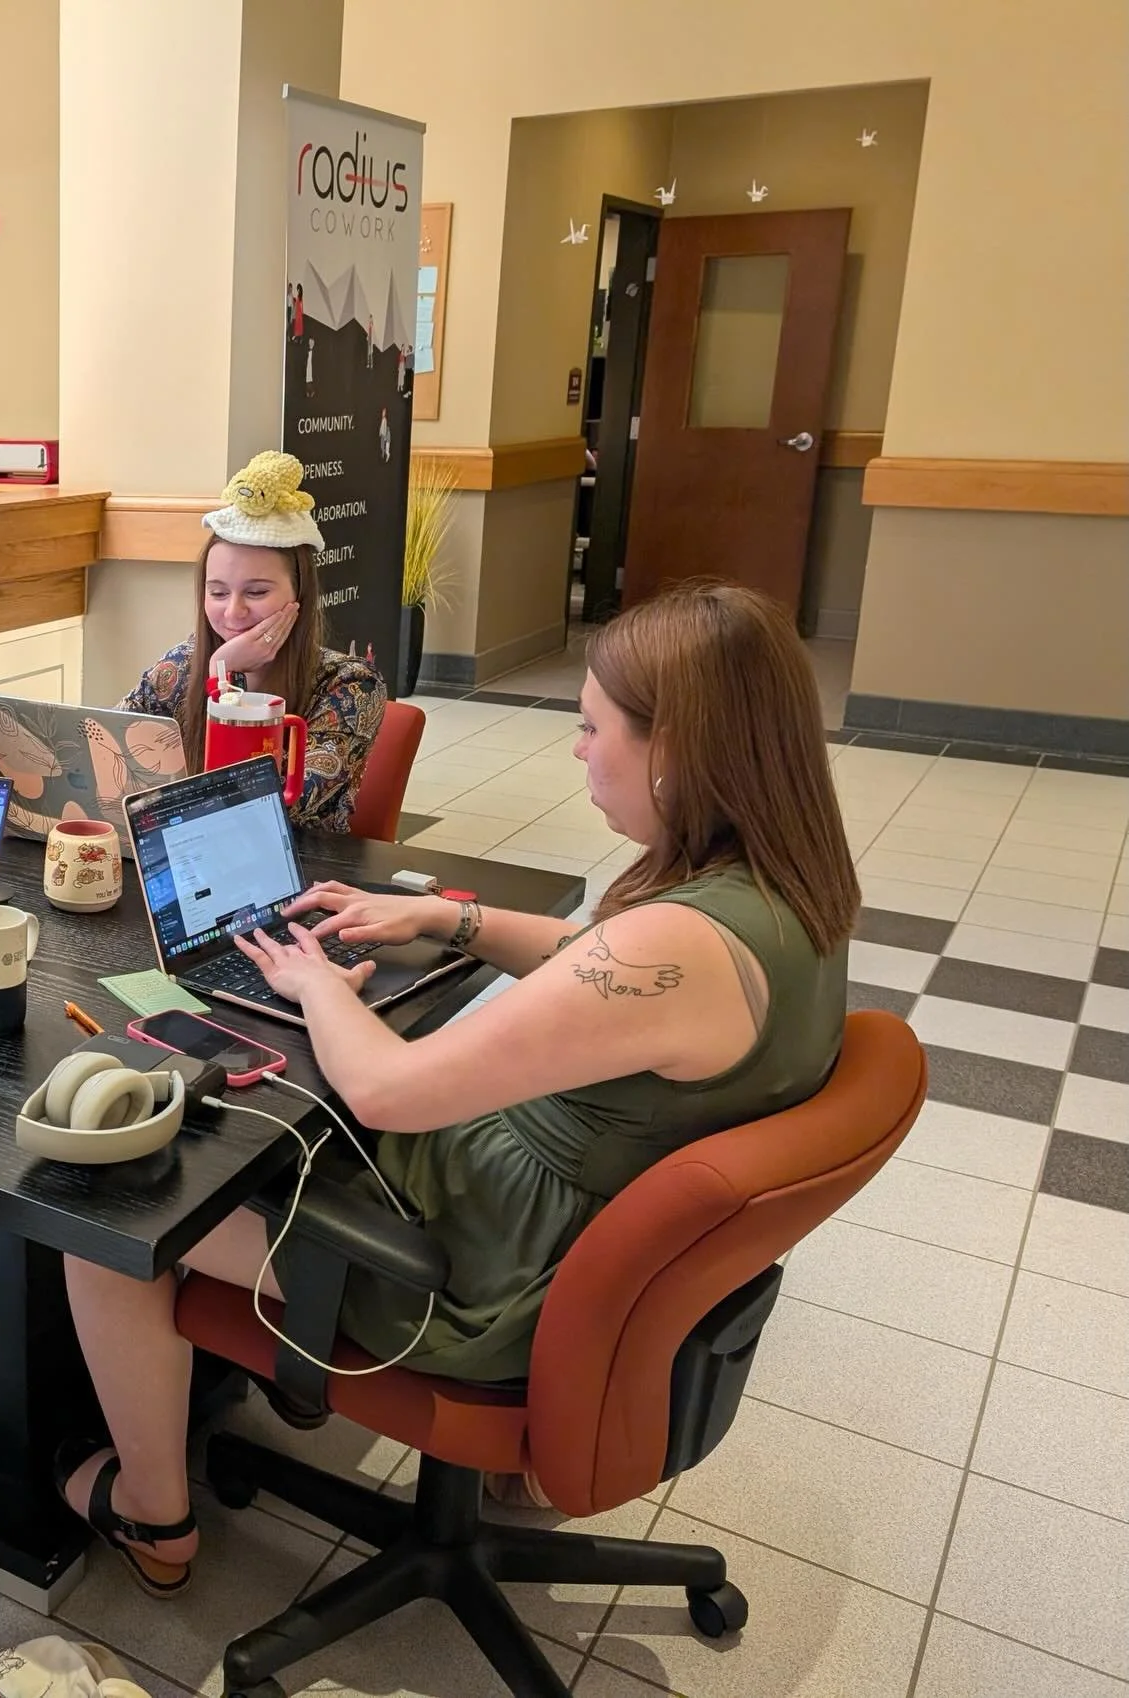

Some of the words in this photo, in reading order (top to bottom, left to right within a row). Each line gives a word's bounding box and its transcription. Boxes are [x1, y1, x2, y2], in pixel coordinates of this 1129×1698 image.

[298, 131, 408, 213] radius
[310, 207, 395, 242] COWORK
[298, 415, 355, 434] COMMUNITY.
[304, 460, 345, 480] PENNESS.
[313, 500, 368, 523] LABORATION.
